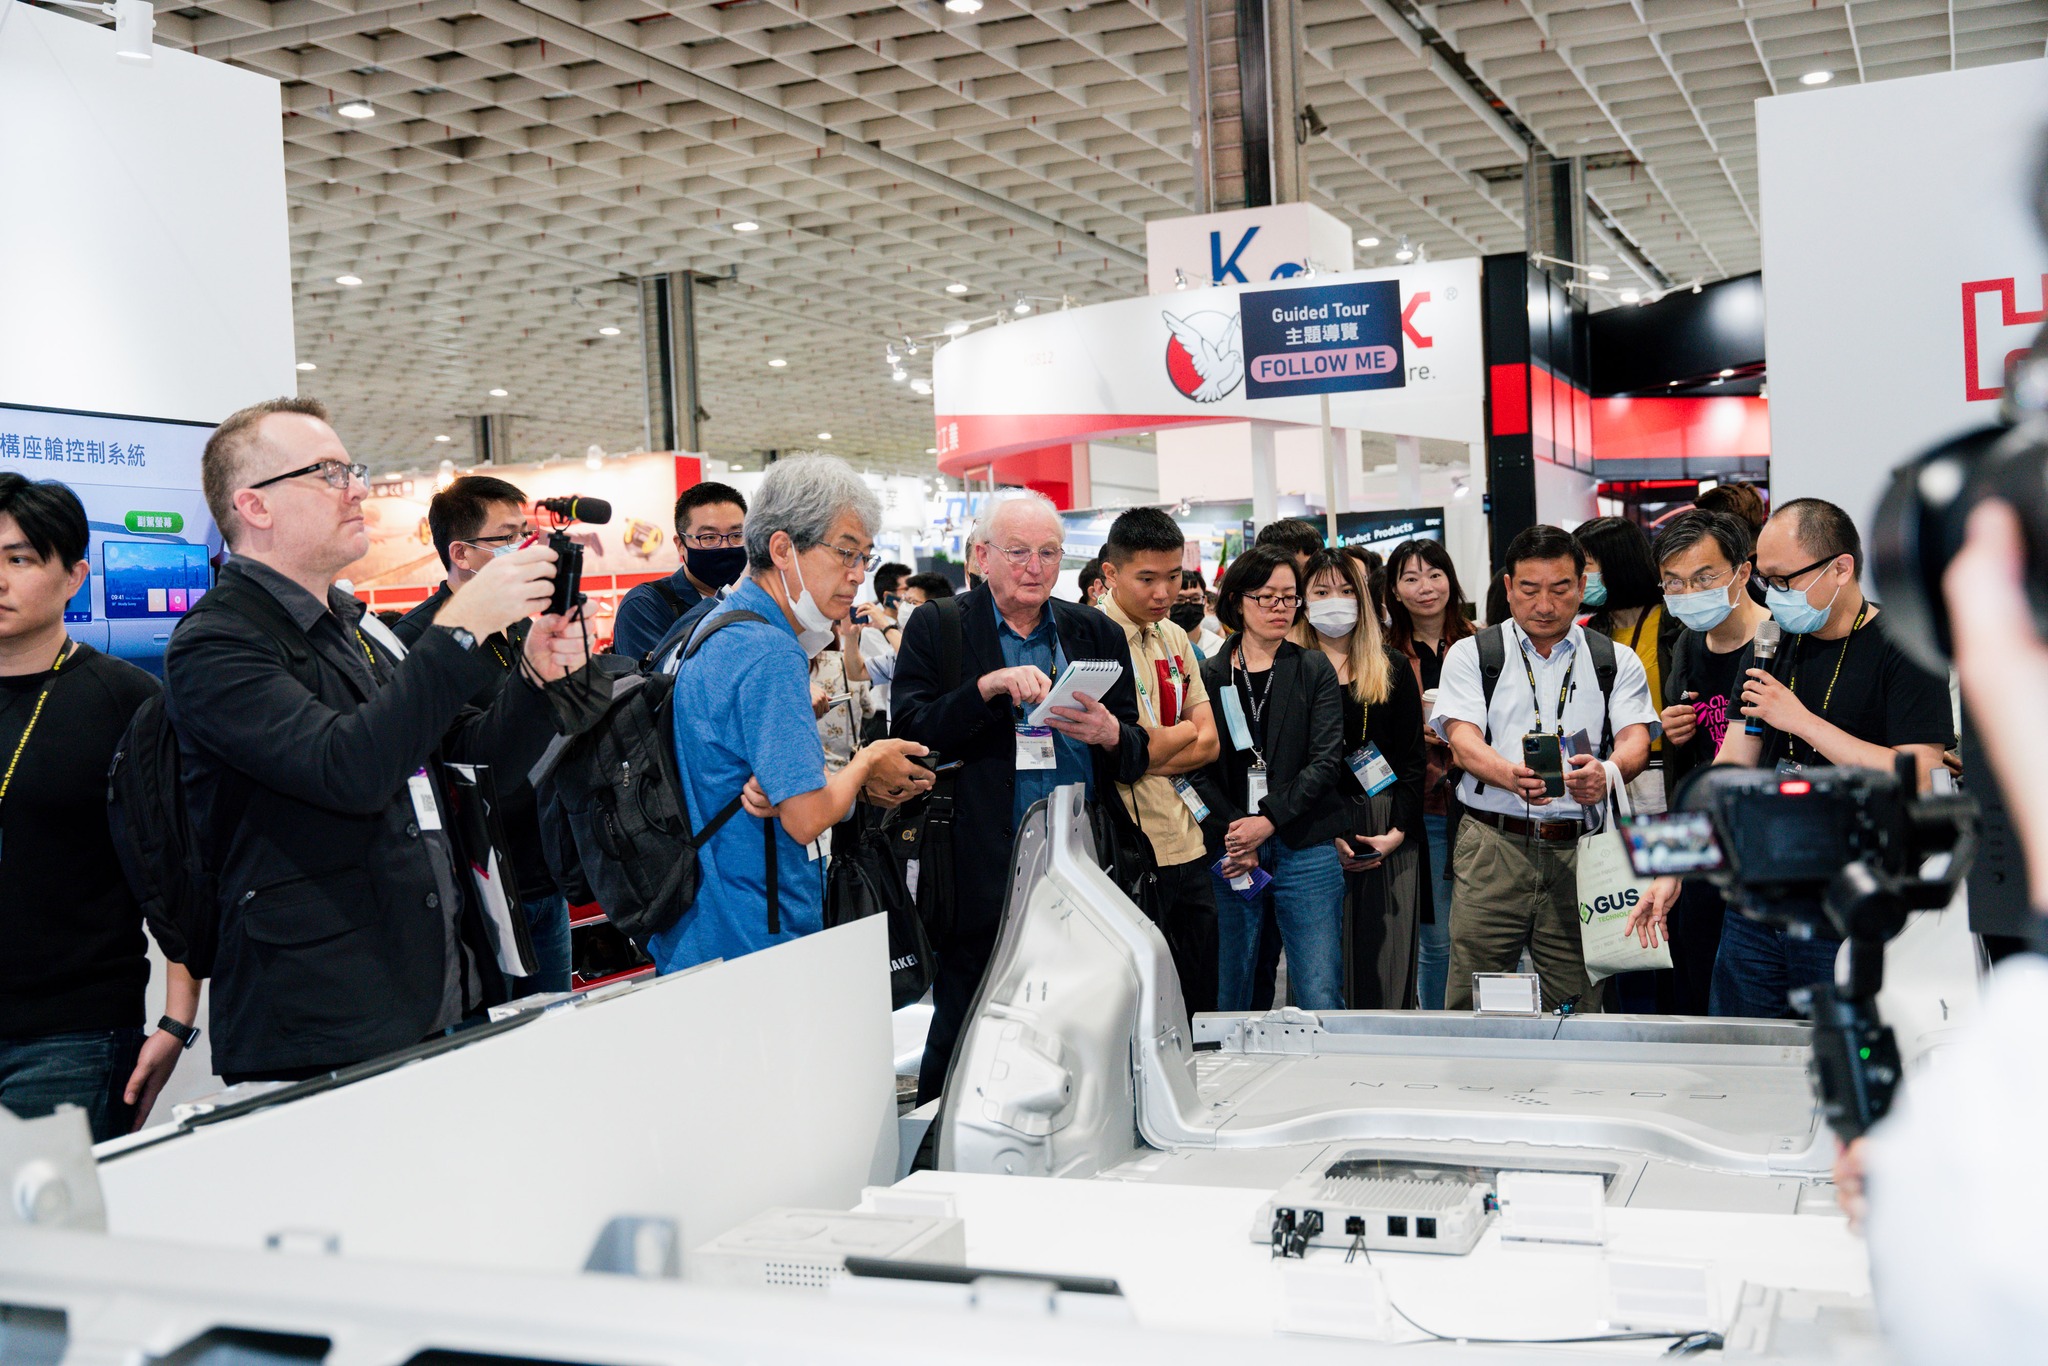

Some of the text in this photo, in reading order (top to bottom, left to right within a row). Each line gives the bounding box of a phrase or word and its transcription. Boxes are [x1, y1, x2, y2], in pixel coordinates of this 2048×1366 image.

[1271, 302, 1370, 323] Guided Tour
[1285, 323, 1359, 346] 主題導覽
[1260, 351, 1387, 378] FOLLOW ME
[1373, 522, 1415, 540] Products
[1593, 888, 1640, 914] GUS
